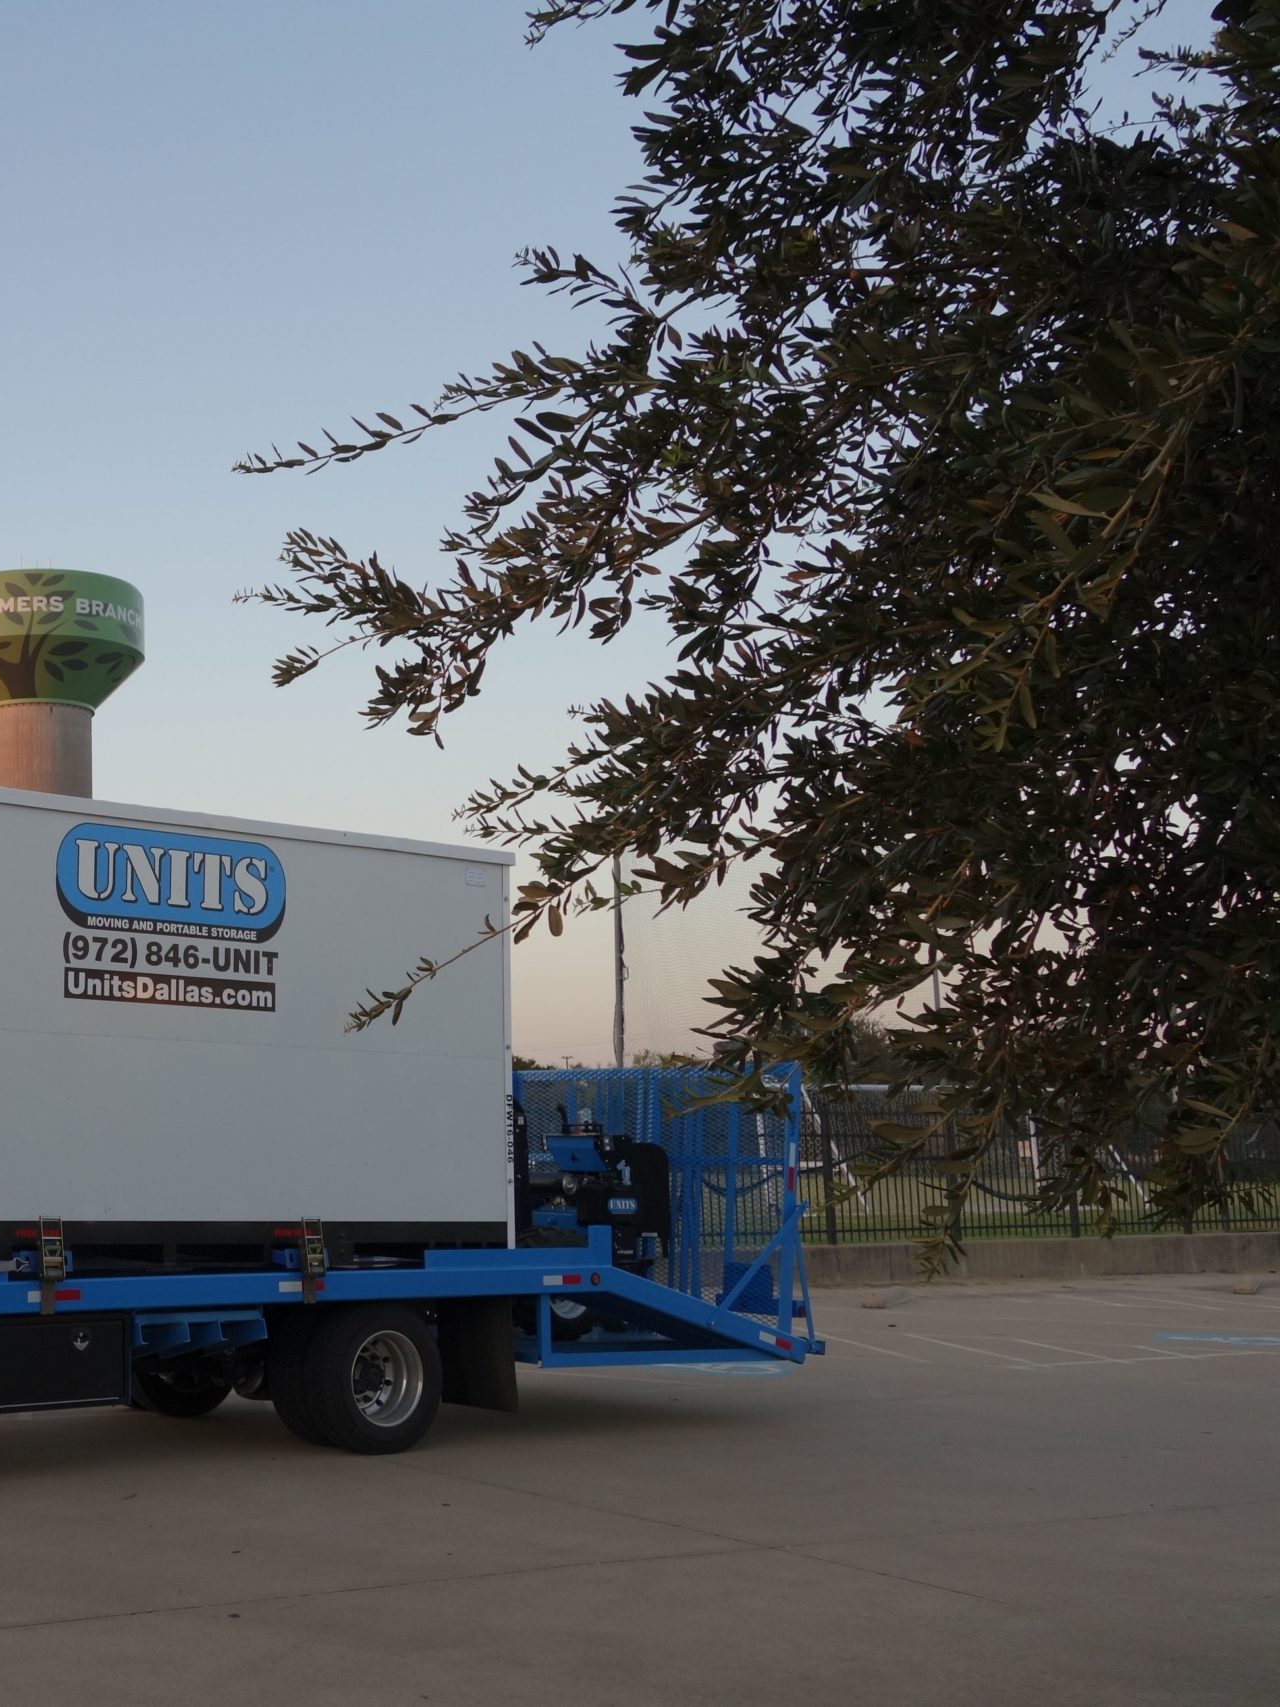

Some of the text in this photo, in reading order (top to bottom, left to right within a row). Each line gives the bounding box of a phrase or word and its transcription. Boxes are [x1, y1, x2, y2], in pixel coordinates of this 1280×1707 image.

[76, 598, 142, 629] BRANCH
[74, 838, 269, 916] UNITS
[87, 916, 257, 940] MOVING AND PORTABLE STORAGE
[62, 931, 279, 976] (972) 846-UNIT
[67, 970, 273, 1008] UnitsDallas.com
[505, 1094, 514, 1163] DFW16-046
[610, 1199, 636, 1210] UNITS
